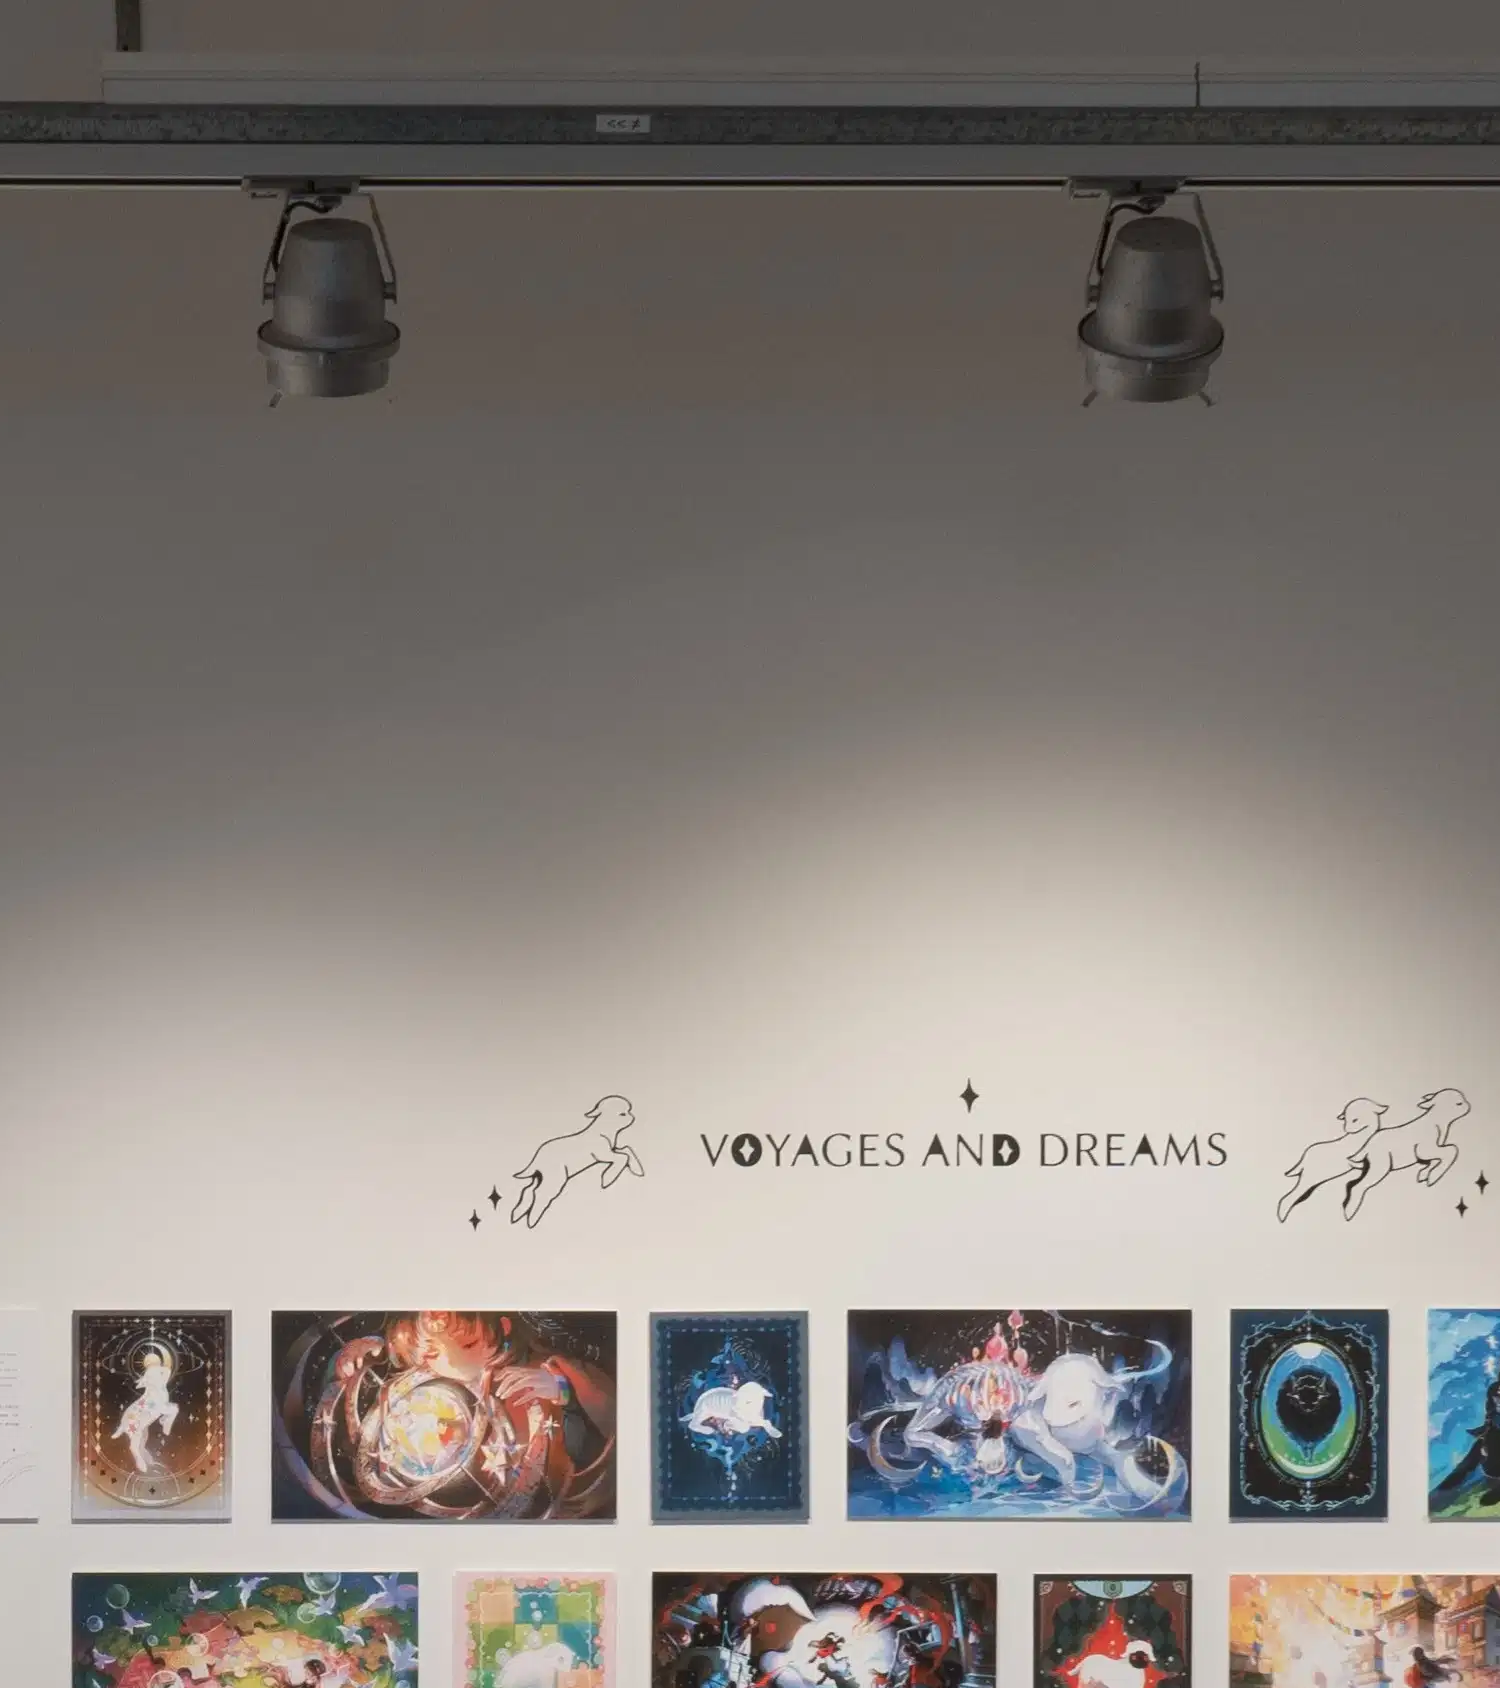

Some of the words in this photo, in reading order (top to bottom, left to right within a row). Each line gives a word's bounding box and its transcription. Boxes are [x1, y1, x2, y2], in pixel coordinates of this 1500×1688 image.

[700, 1132, 906, 1167] VOYAGES
[921, 1132, 1022, 1167] AND
[1040, 1132, 1228, 1167] DREAMS
